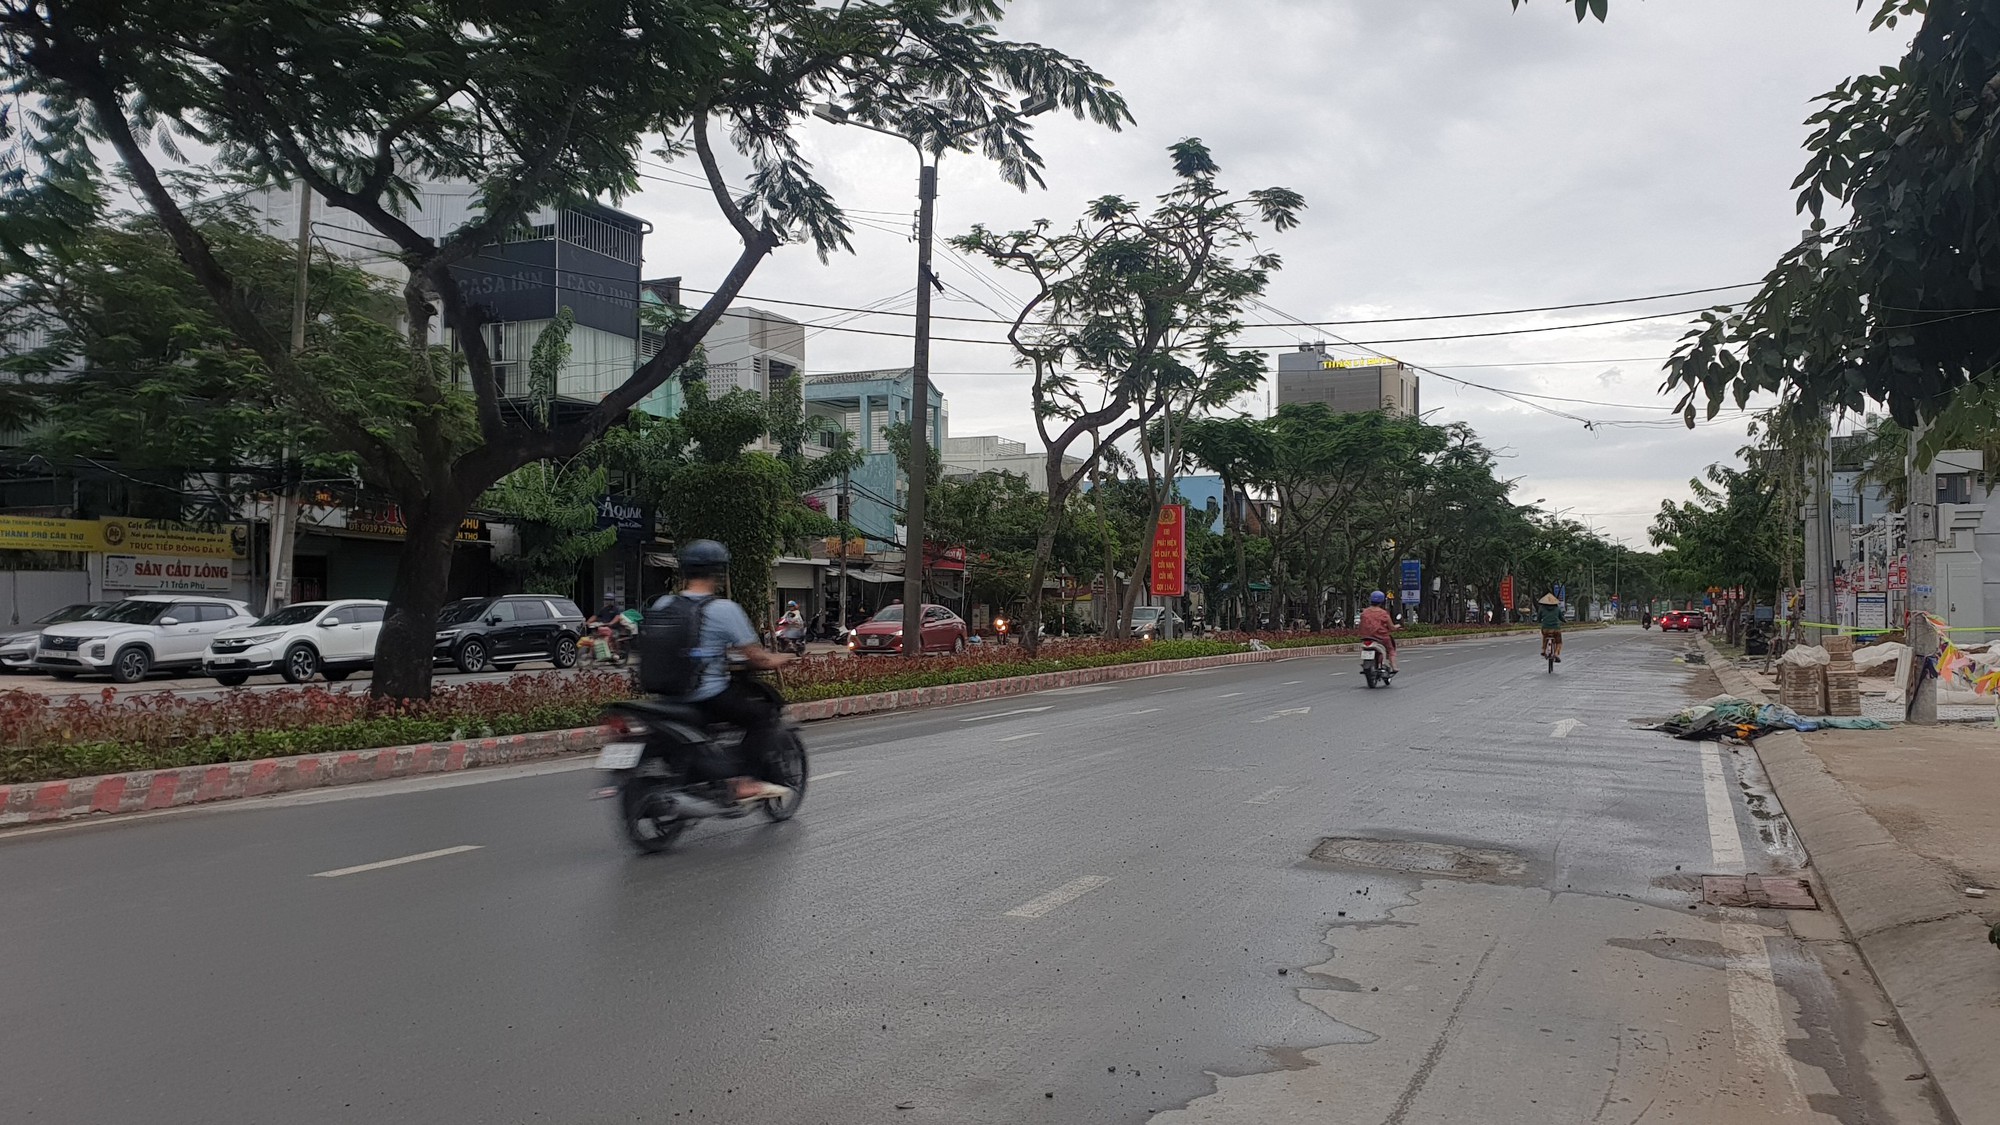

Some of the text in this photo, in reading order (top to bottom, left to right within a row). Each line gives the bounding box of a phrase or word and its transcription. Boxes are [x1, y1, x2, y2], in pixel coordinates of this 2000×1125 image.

[458, 271, 543, 296] CASA INN
[567, 274, 633, 309] CASA INN
[360, 523, 378, 532] 0939
[134, 559, 229, 578] SÂN CẦU LÔNG
